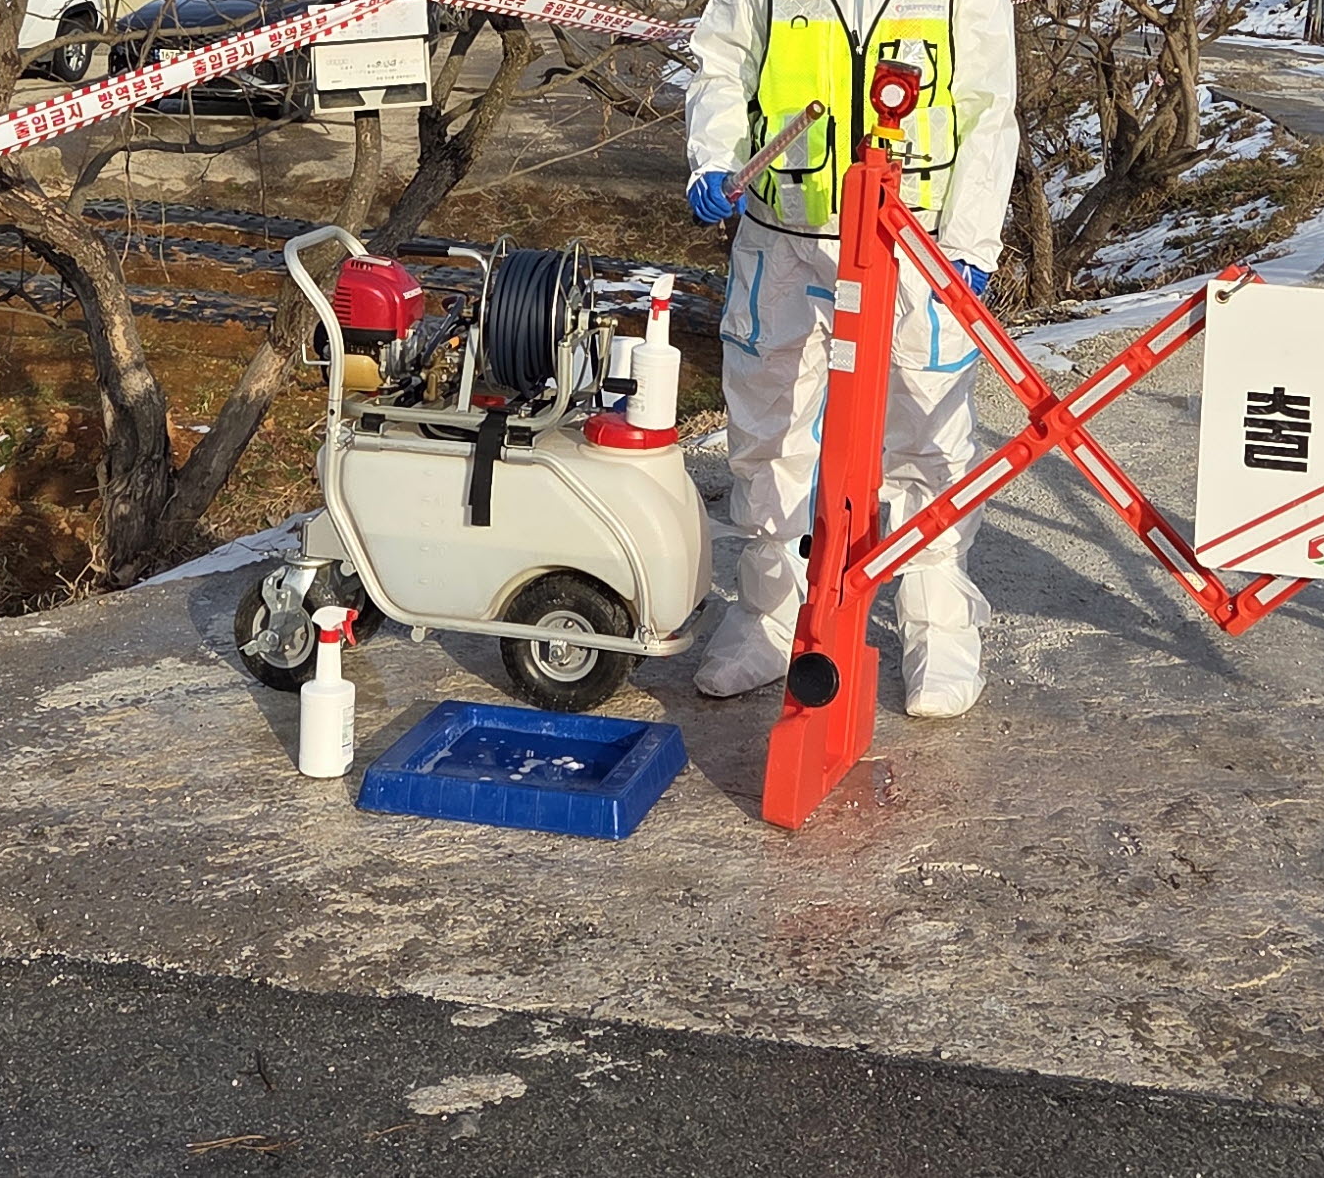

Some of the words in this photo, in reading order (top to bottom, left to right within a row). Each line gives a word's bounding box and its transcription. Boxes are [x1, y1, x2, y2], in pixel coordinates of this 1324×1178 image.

[541, 1, 587, 21] 출입금지
[589, 12, 634, 30] 방역본부
[13, 102, 84, 140] 출입금지
[97, 73, 166, 111] 방역본부
[191, 40, 256, 76] 출입금지
[268, 13, 328, 48] 방역본부
